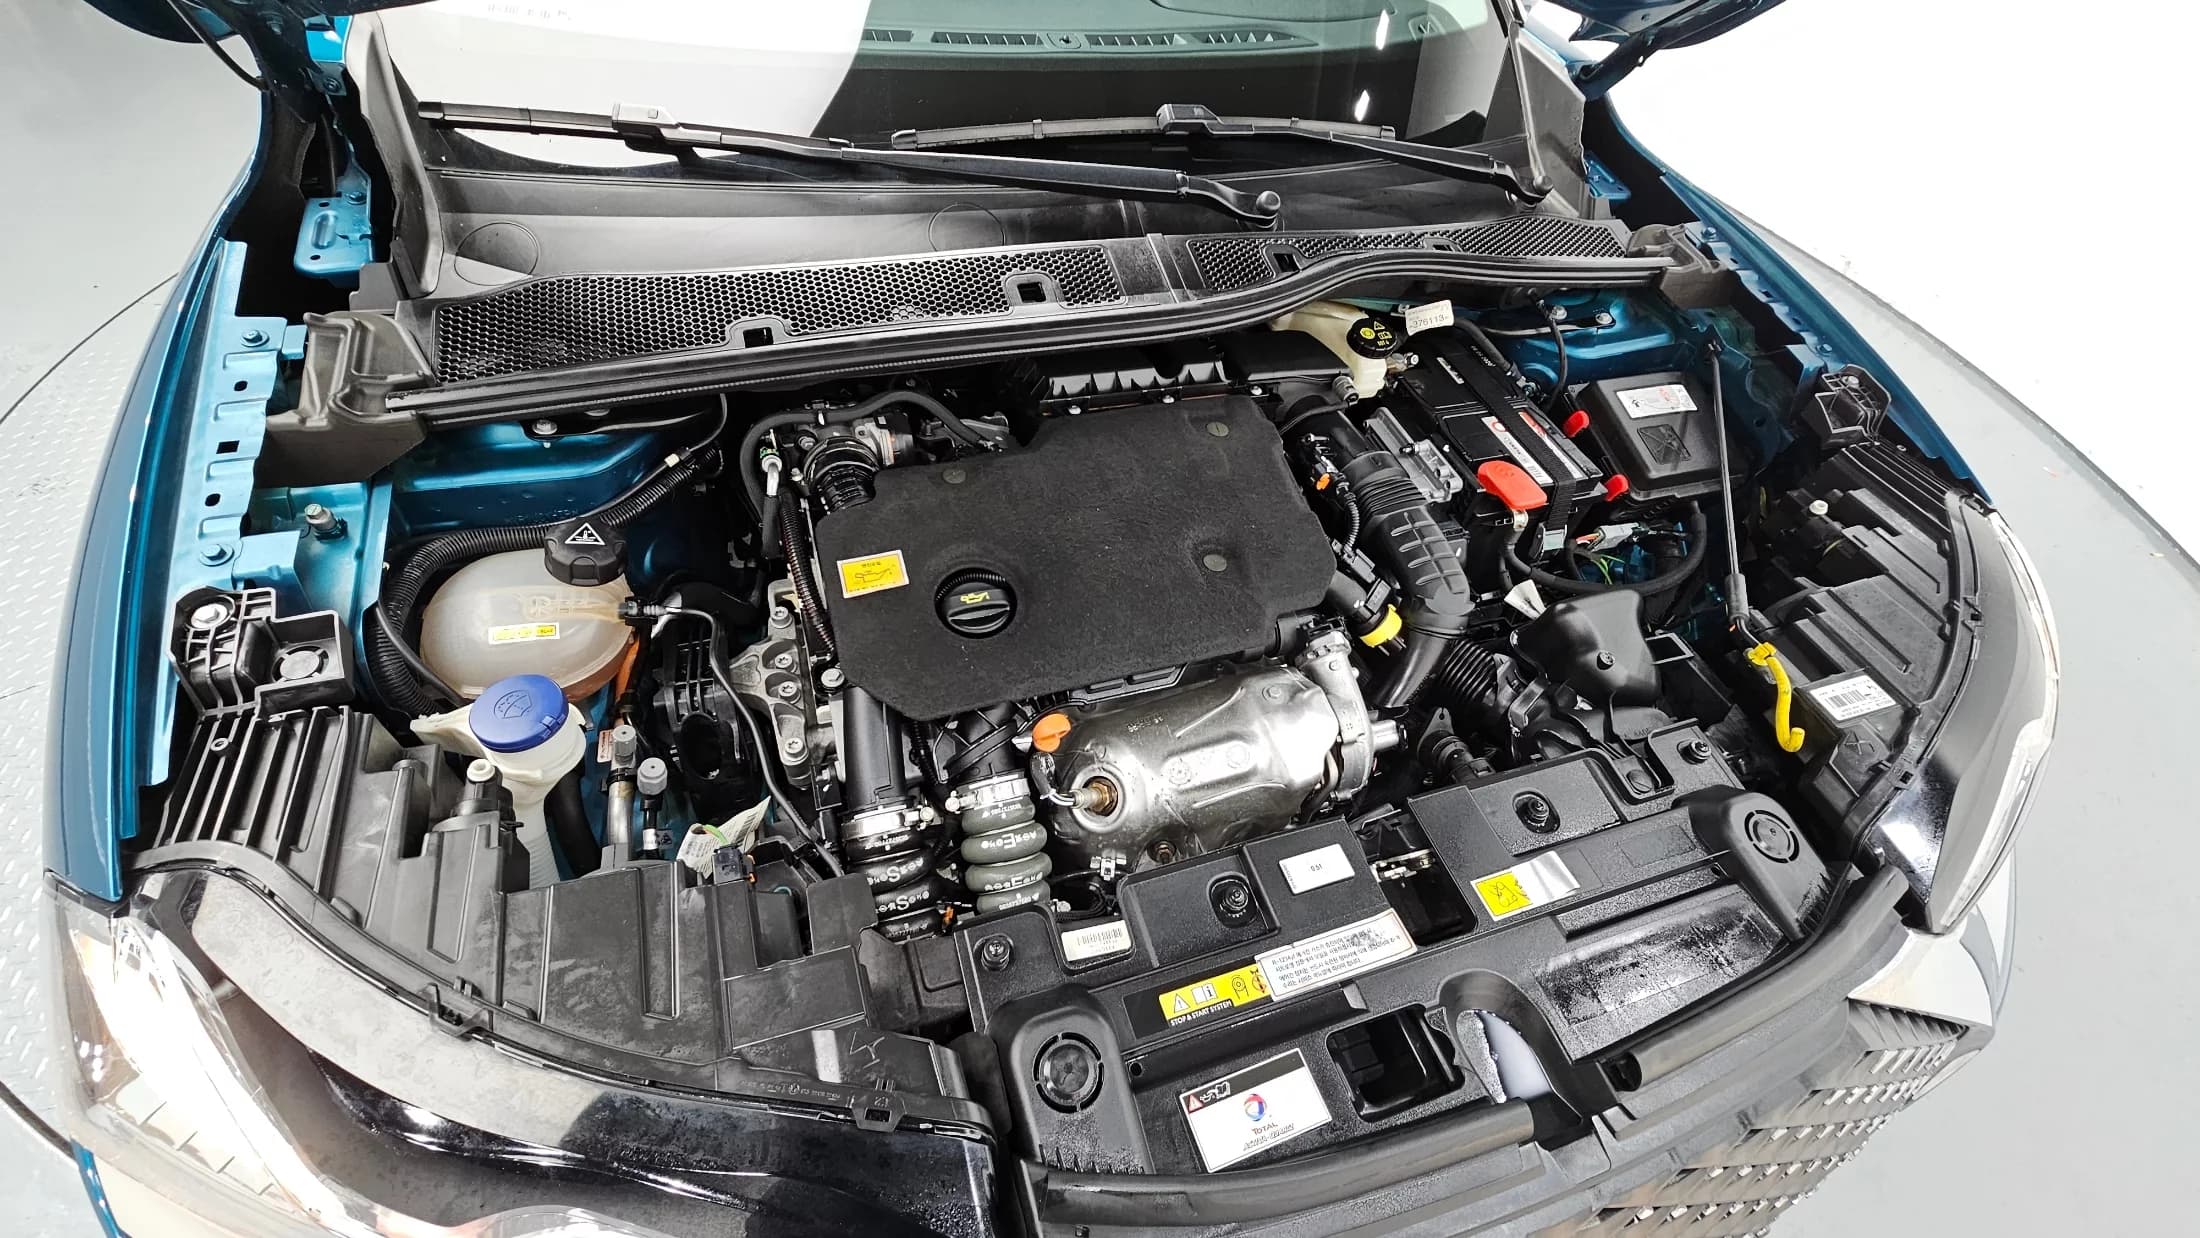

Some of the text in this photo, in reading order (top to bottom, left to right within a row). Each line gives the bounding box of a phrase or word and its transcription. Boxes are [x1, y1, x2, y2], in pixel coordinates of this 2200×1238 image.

[1170, 1015, 1186, 1026] STOP
[1191, 1007, 1209, 1019] START
[1209, 999, 1232, 1013] SYSTEM
[1251, 1122, 1278, 1135] TOTAL
